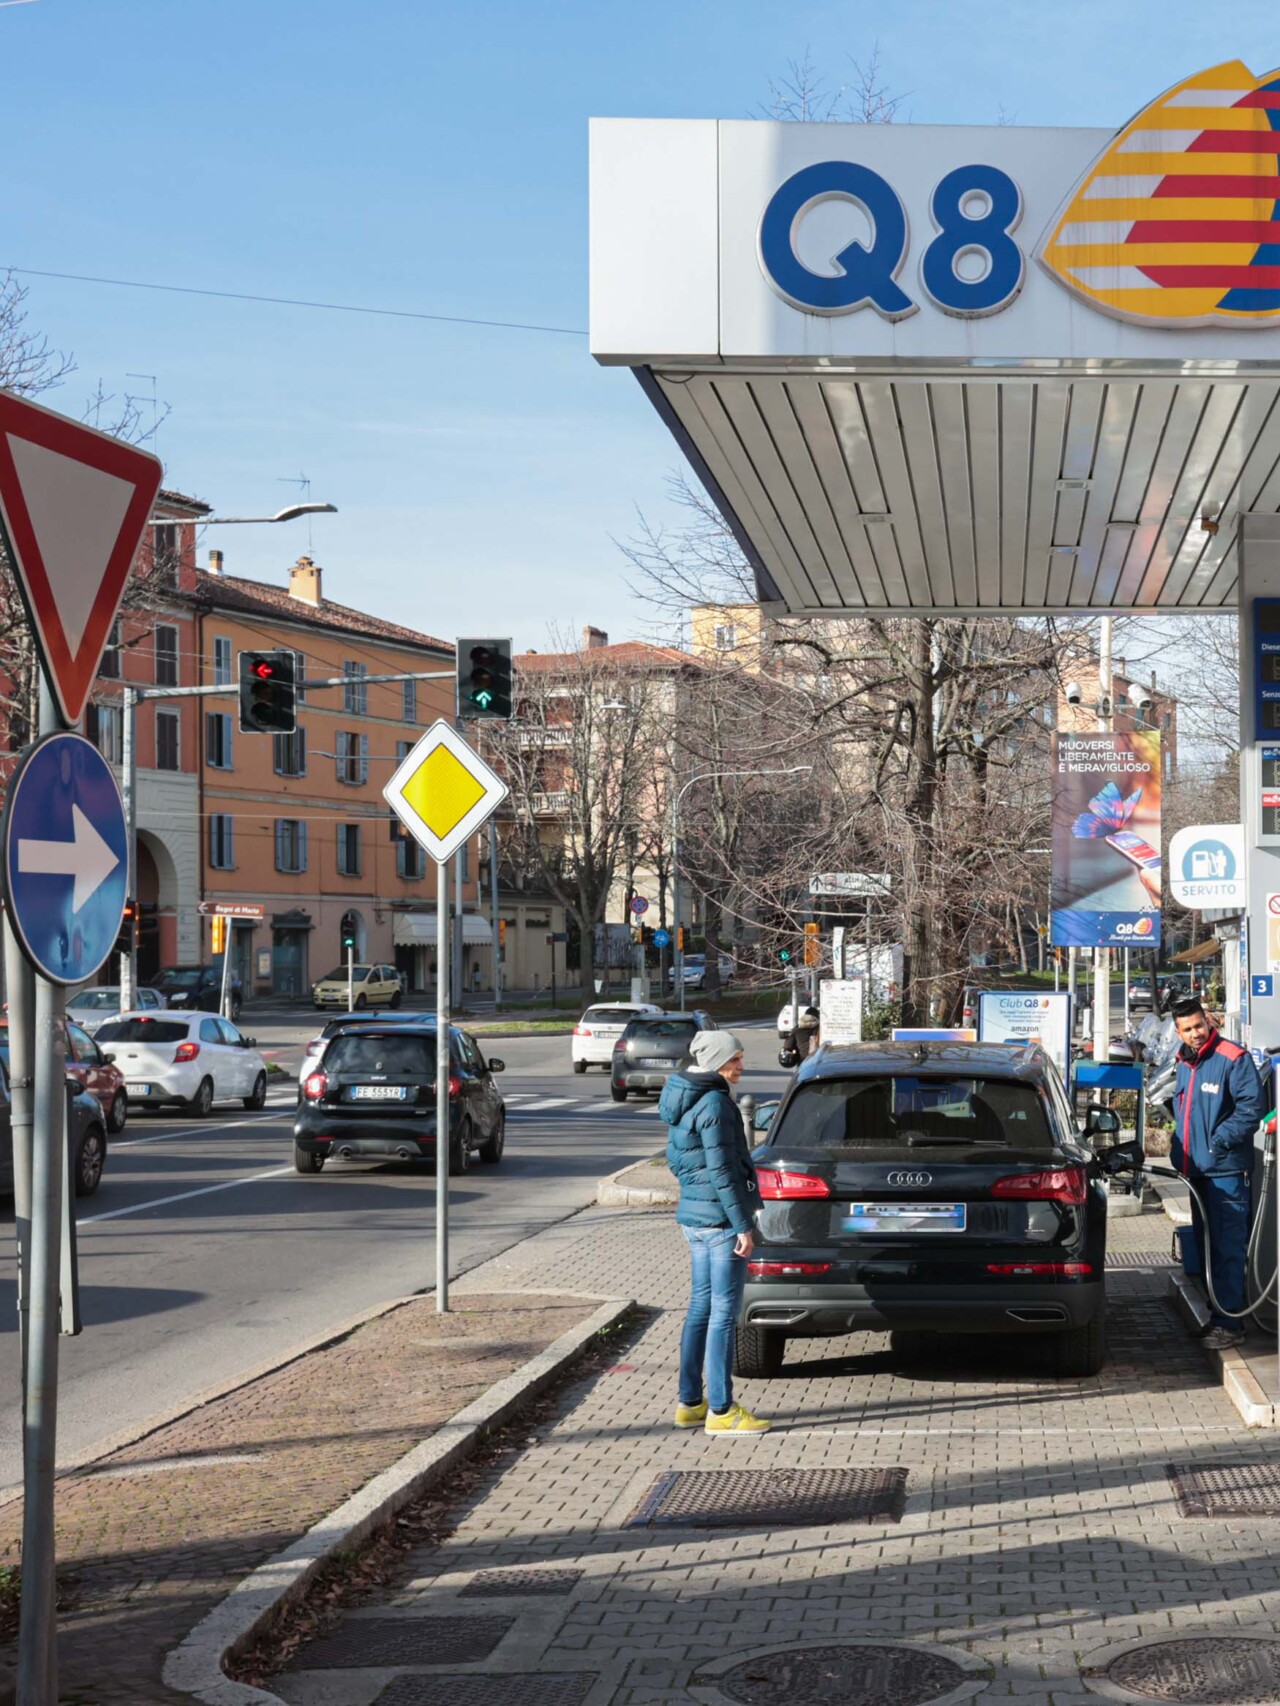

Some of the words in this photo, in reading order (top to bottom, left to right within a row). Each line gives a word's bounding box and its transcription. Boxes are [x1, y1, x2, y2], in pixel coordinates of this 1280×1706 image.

[757, 160, 1026, 322] Q8
[1058, 741, 1114, 750] MUOVERSI
[1058, 752, 1134, 761] LIBERAMENTE
[1058, 763, 1066, 773] È
[1068, 763, 1151, 772] MERAVIGLIOSO
[1182, 884, 1237, 896] SERVITO
[1116, 923, 1133, 935] Q8
[1257, 980, 1267, 993] 3
[999, 998, 1023, 1008] Club
[1024, 999, 1039, 1008] Q8
